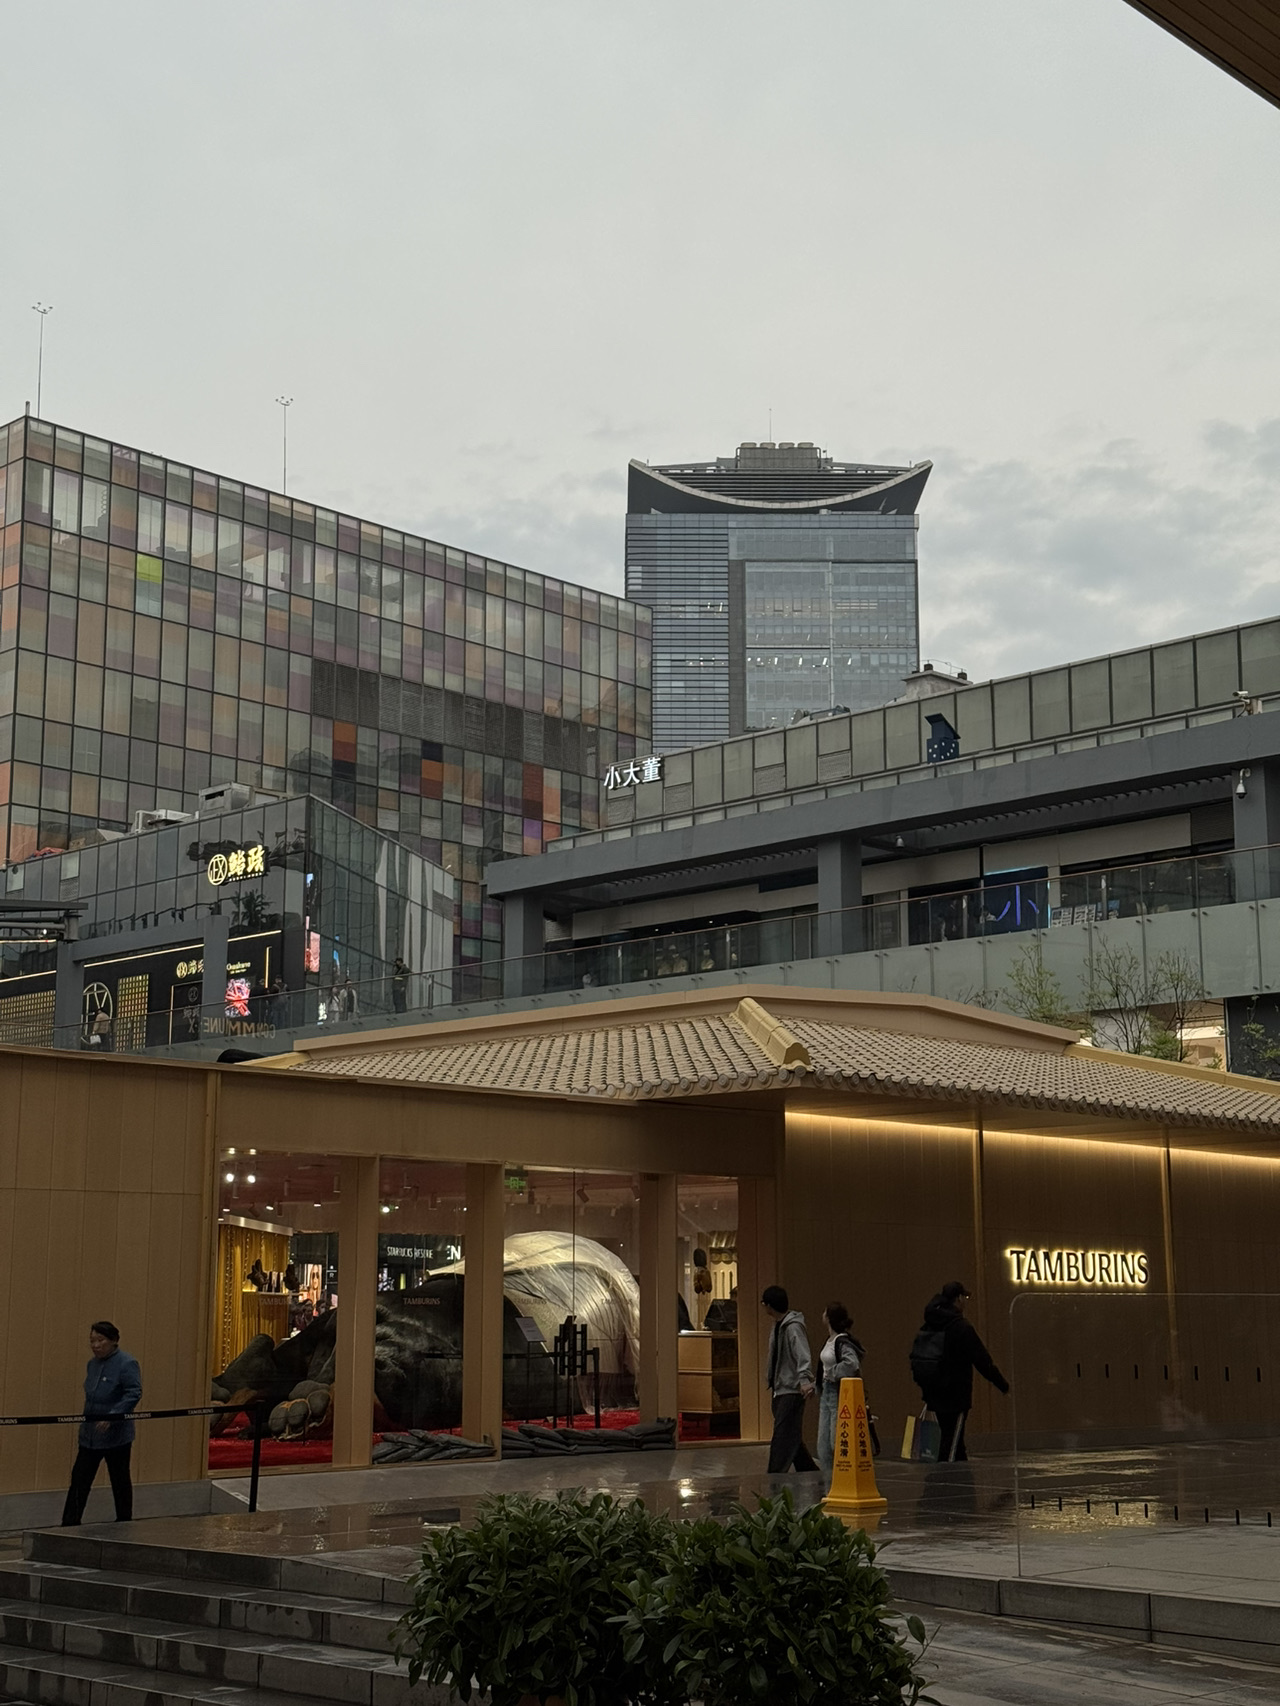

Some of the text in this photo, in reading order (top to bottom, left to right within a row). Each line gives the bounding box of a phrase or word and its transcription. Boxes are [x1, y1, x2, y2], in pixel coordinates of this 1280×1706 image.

[603, 757, 661, 790] 小大董
[996, 884, 1039, 927] 小
[1007, 1248, 1149, 1284] TAMBURINS
[402, 1297, 441, 1306] TAMBURINS
[840, 1421, 849, 1457] 小心地滑
[857, 1421, 867, 1457] 小心地滑
